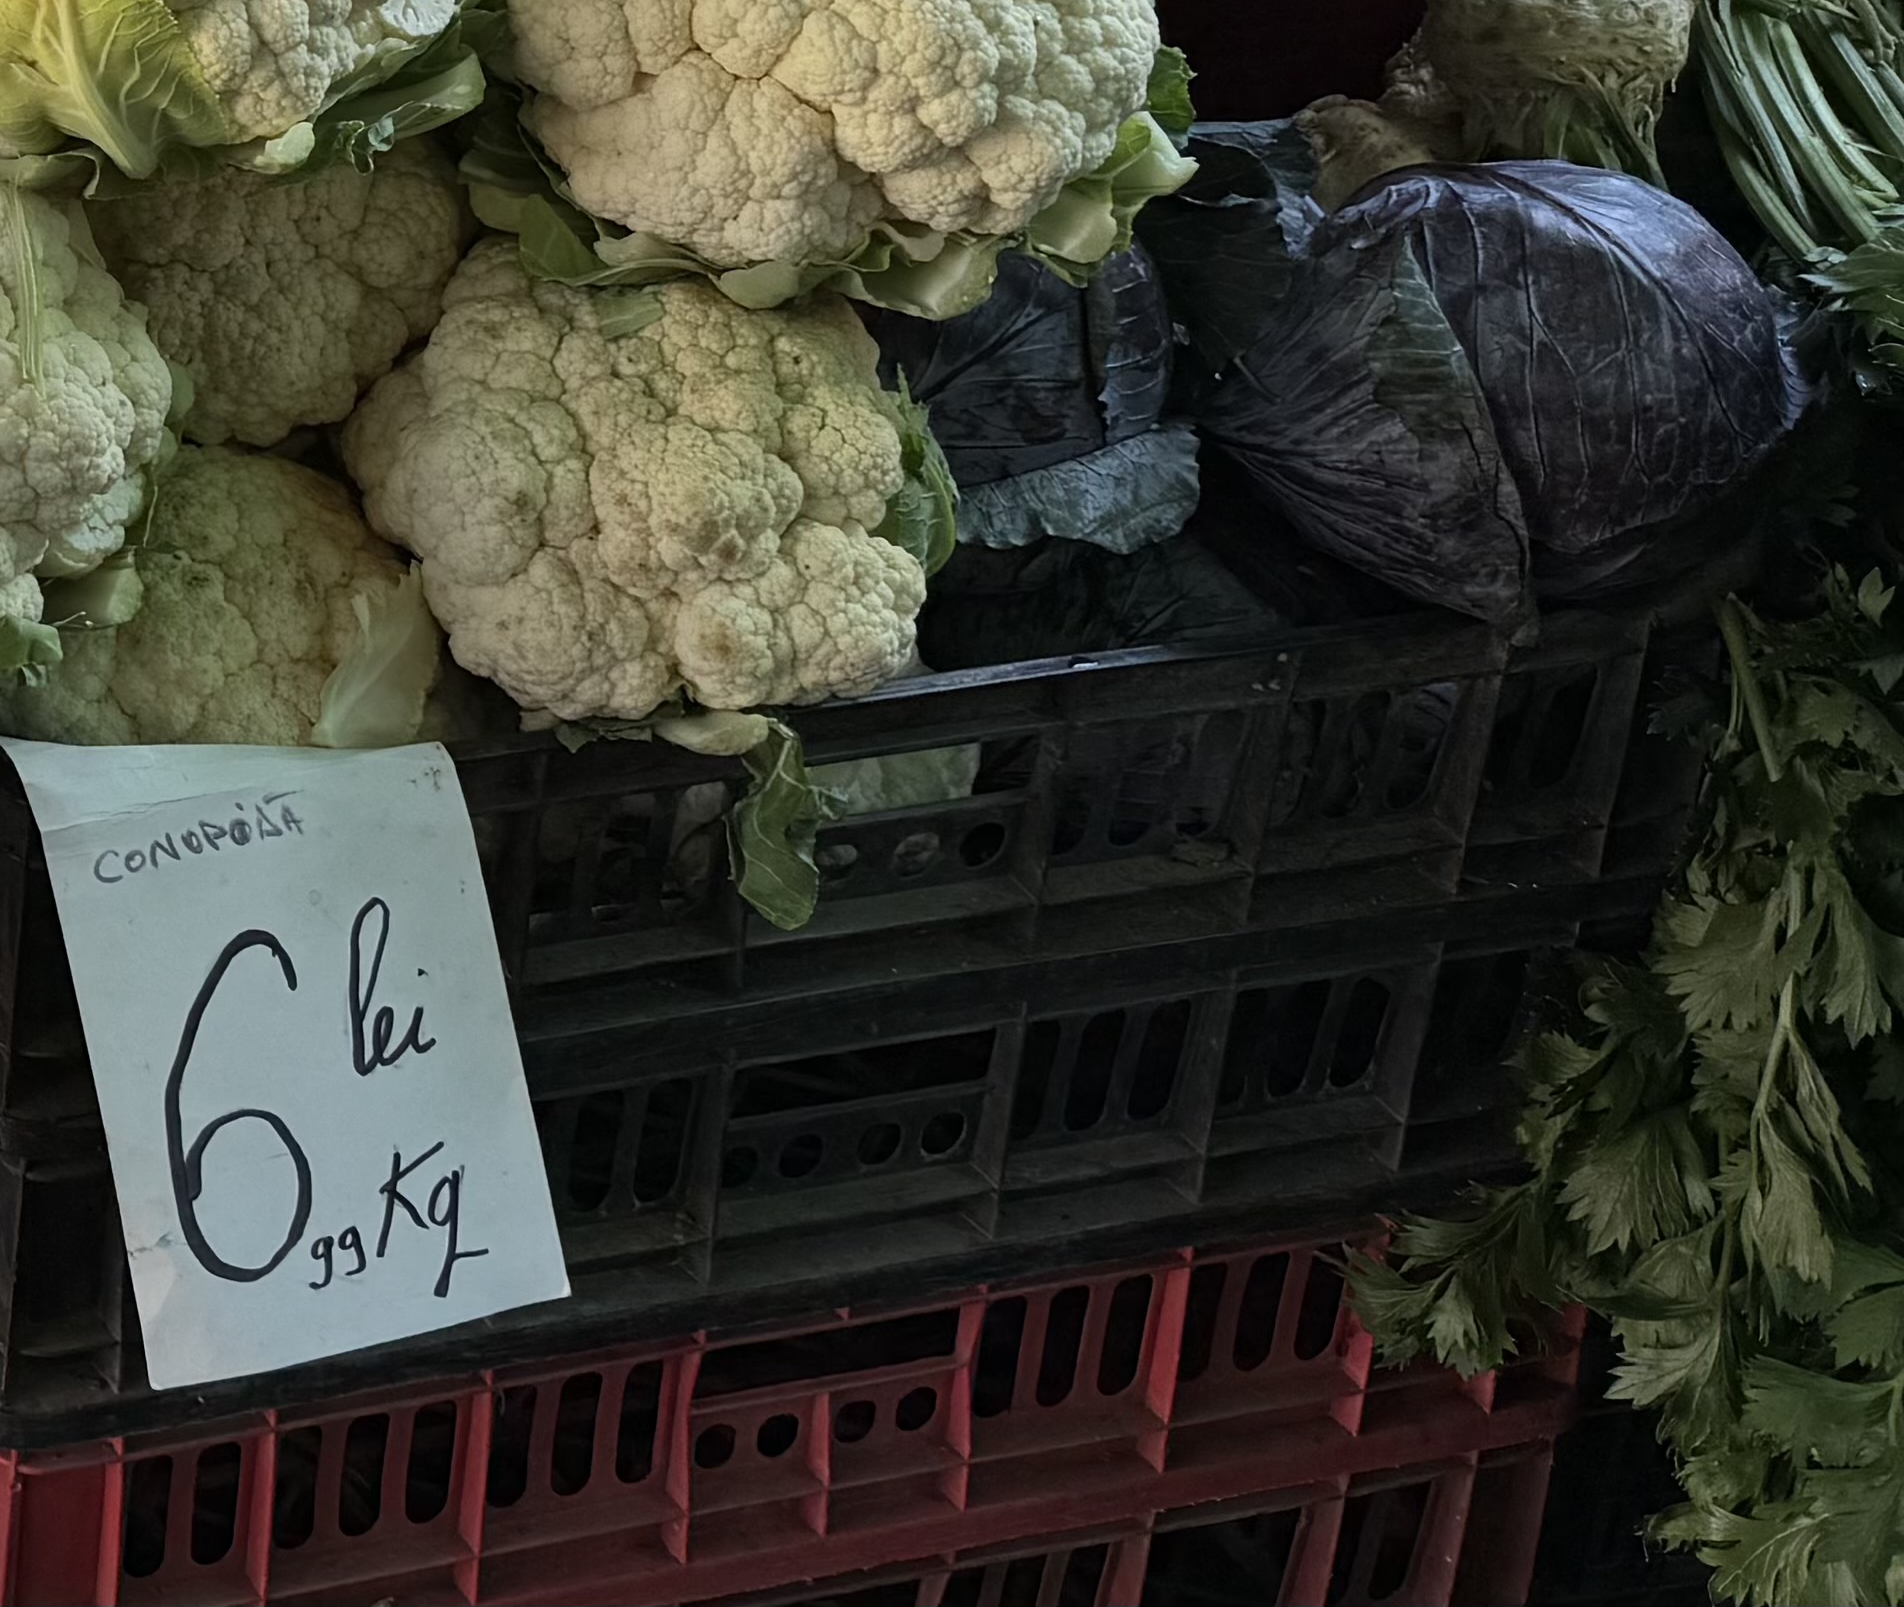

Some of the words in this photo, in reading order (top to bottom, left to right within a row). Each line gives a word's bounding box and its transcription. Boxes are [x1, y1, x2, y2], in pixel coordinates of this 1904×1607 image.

[164, 929, 313, 1282] 6
[349, 897, 436, 1076] lei
[376, 1141, 489, 1298] Kg
